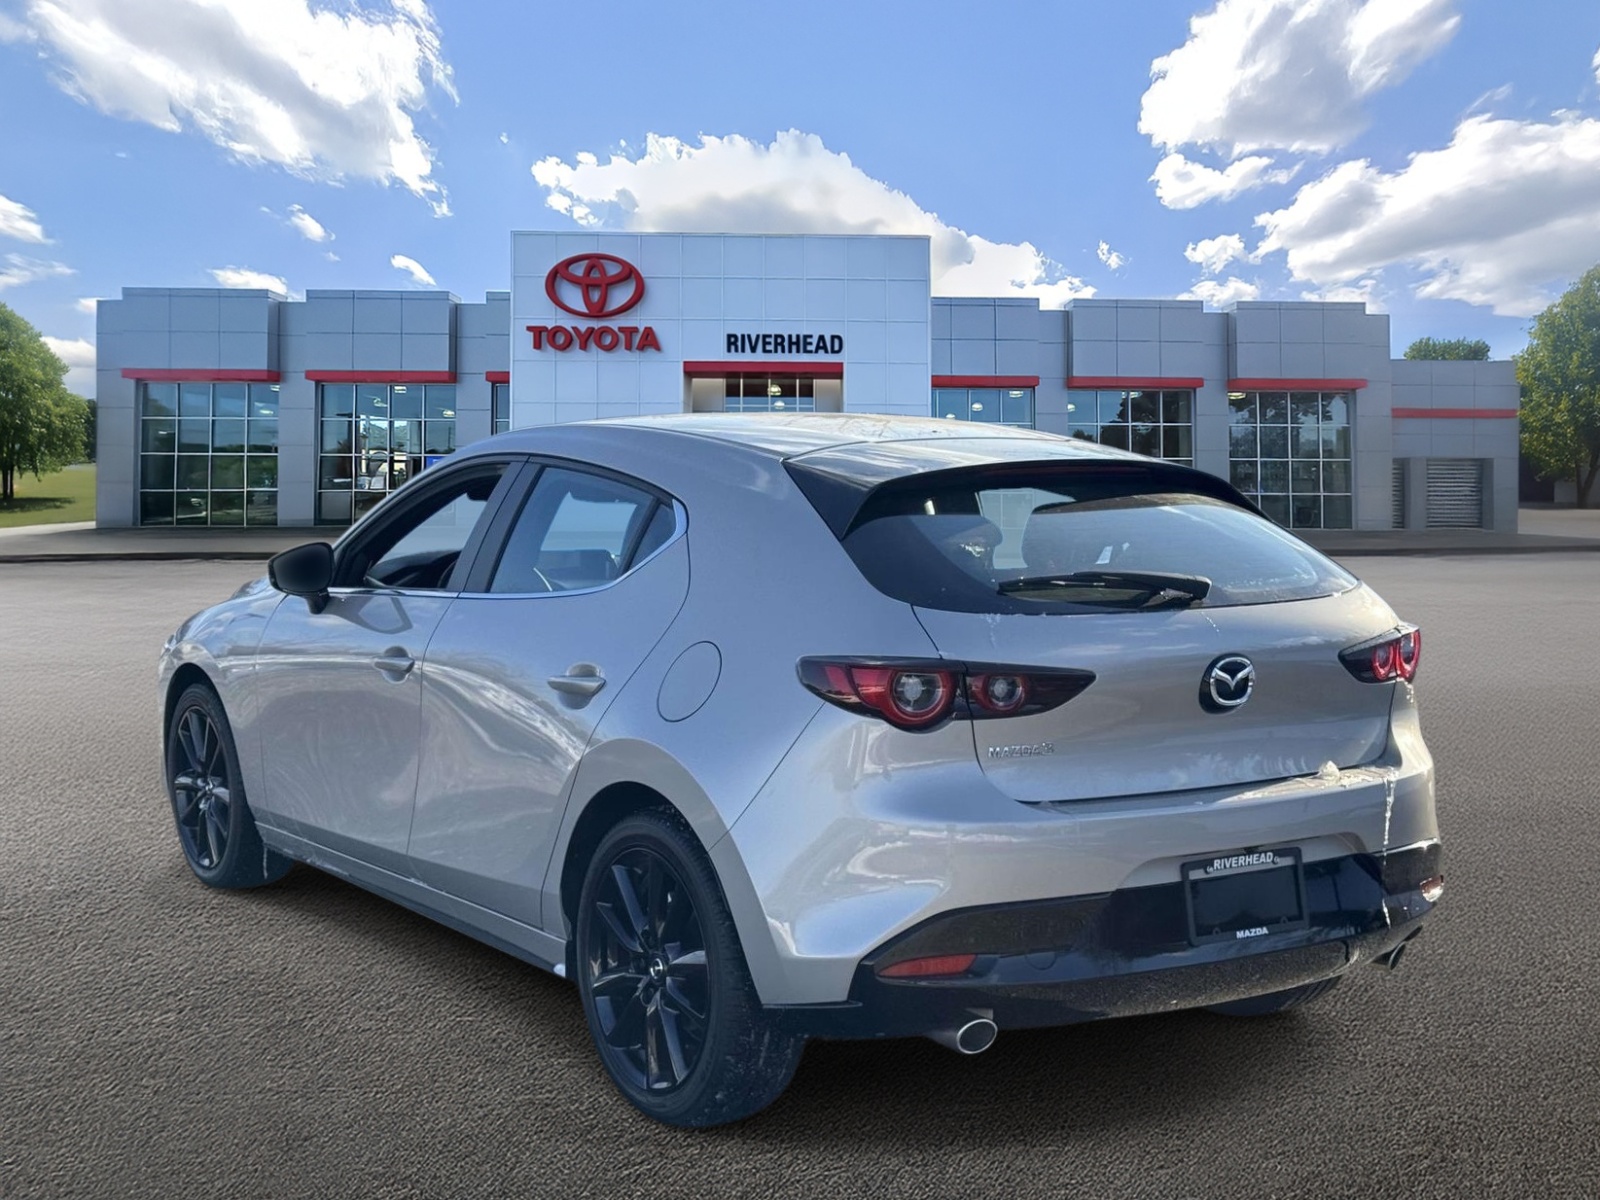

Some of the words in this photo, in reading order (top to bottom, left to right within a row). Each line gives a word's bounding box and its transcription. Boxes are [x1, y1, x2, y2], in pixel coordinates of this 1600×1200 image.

[527, 326, 661, 352] TOYOTA
[726, 333, 844, 355] RIVERHEAD
[1213, 852, 1274, 870] RIVERHEAD
[1236, 926, 1269, 939] MAZDA
